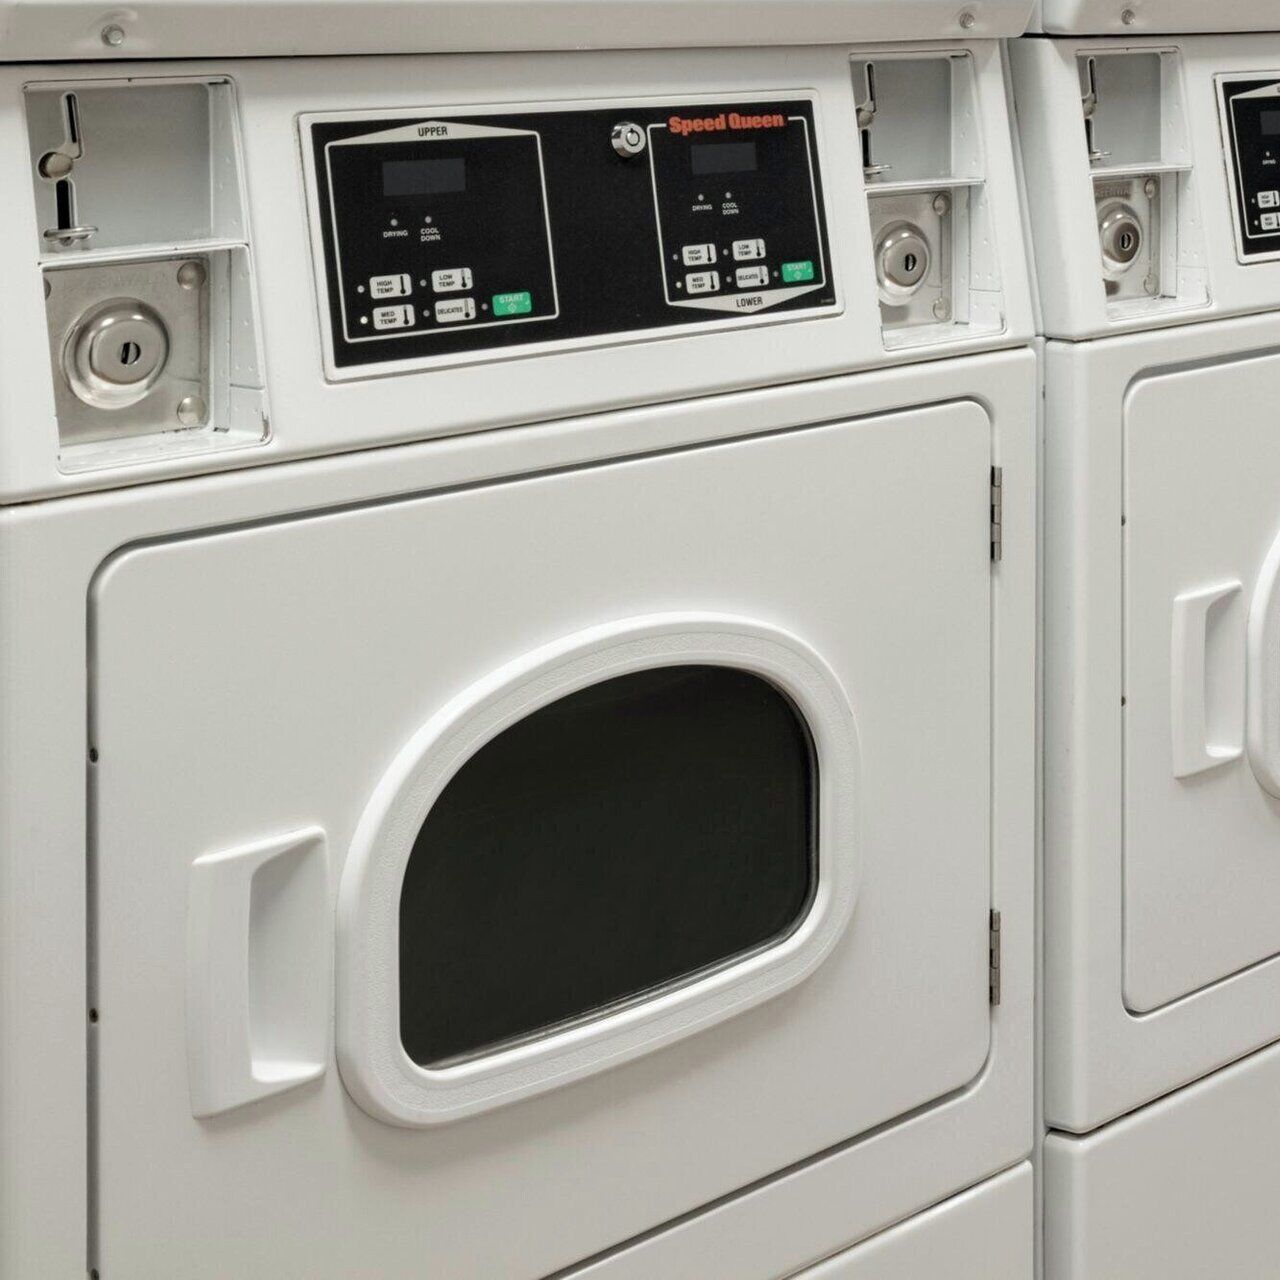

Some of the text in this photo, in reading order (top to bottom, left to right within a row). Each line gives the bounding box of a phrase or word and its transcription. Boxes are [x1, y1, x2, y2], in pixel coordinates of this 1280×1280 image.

[668, 112, 784, 136] Speed Queen
[418, 126, 448, 136] UPPER
[382, 229, 409, 238] DRYING
[420, 227, 440, 235] COOL
[420, 234, 441, 242] DOWN
[376, 279, 393, 287] HIGH
[438, 280, 455, 289] TEMP
[376, 287, 394, 295] TEMP
[499, 294, 524, 304] START
[735, 297, 763, 308] LOWER
[437, 306, 464, 316] DELICATES
